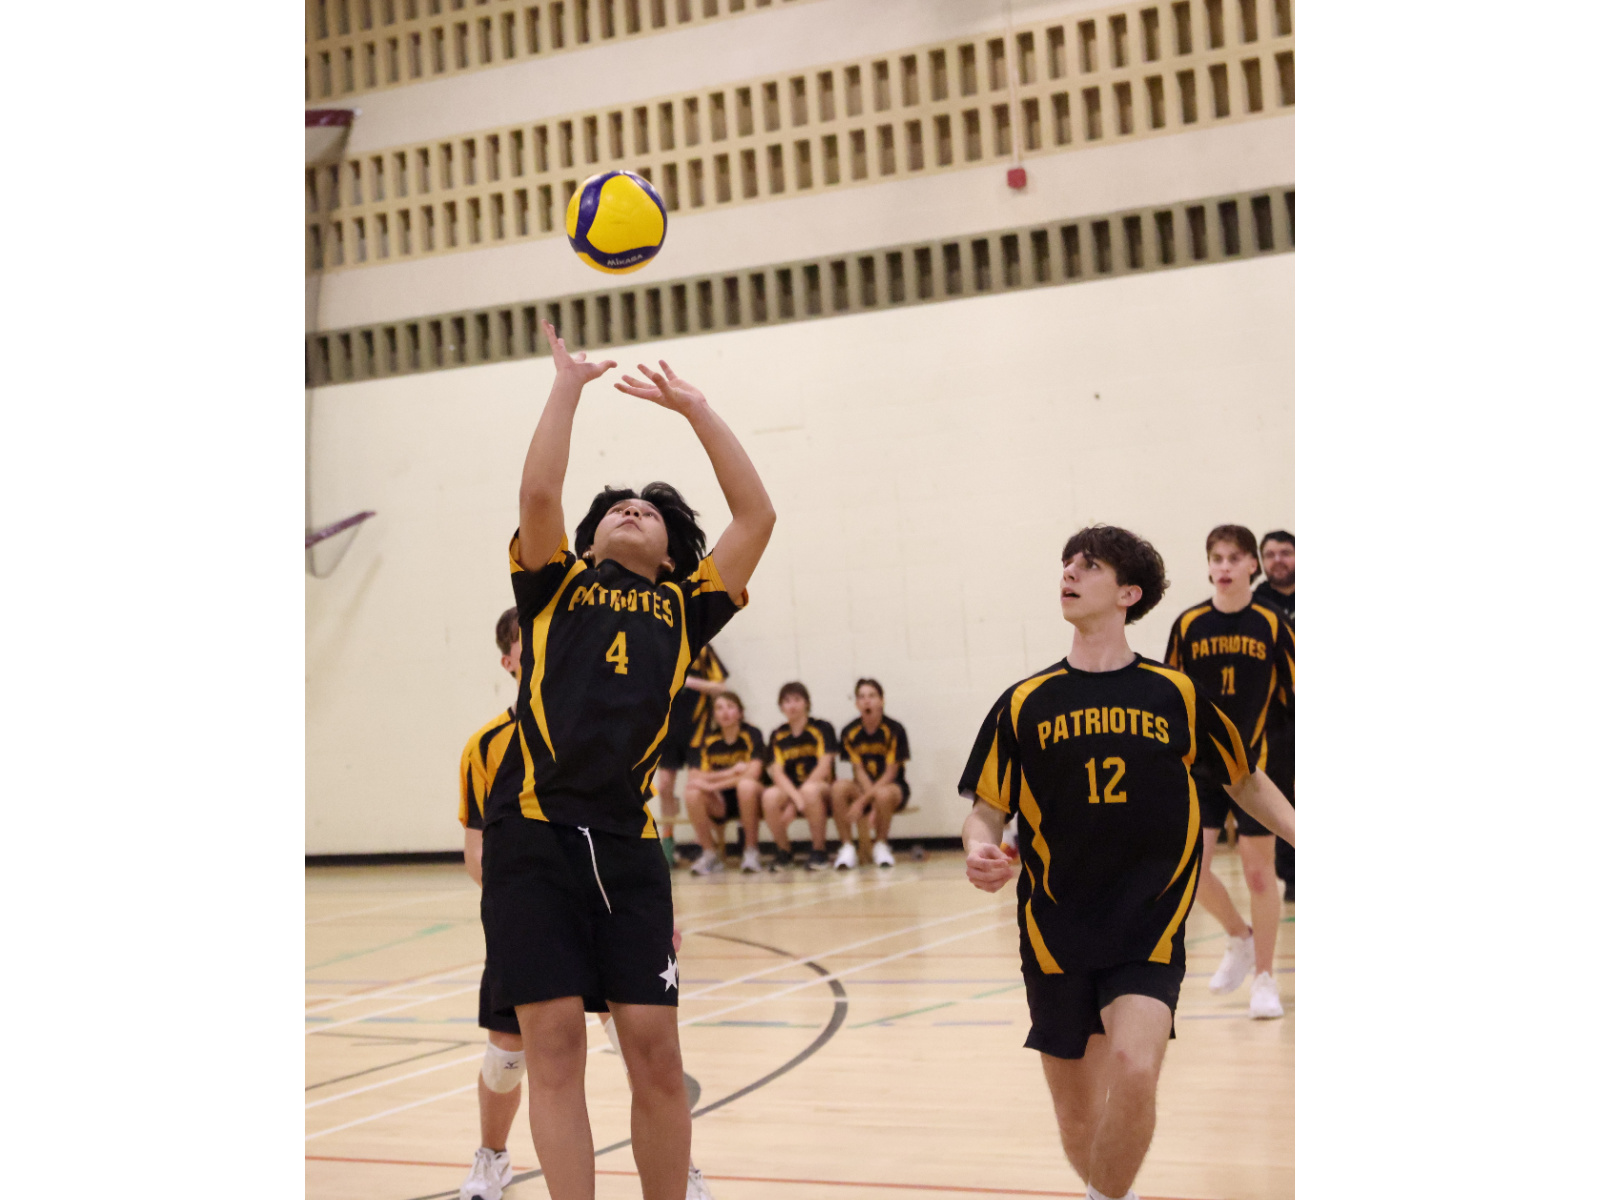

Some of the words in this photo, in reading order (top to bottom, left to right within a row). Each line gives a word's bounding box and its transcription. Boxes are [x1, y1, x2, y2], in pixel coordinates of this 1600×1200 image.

[605, 631, 629, 675] 4
[1191, 634, 1267, 661] PATRIOTES
[1221, 665, 1236, 696] 11
[1037, 706, 1170, 750] PATRIOTES
[1084, 756, 1127, 804] 12
